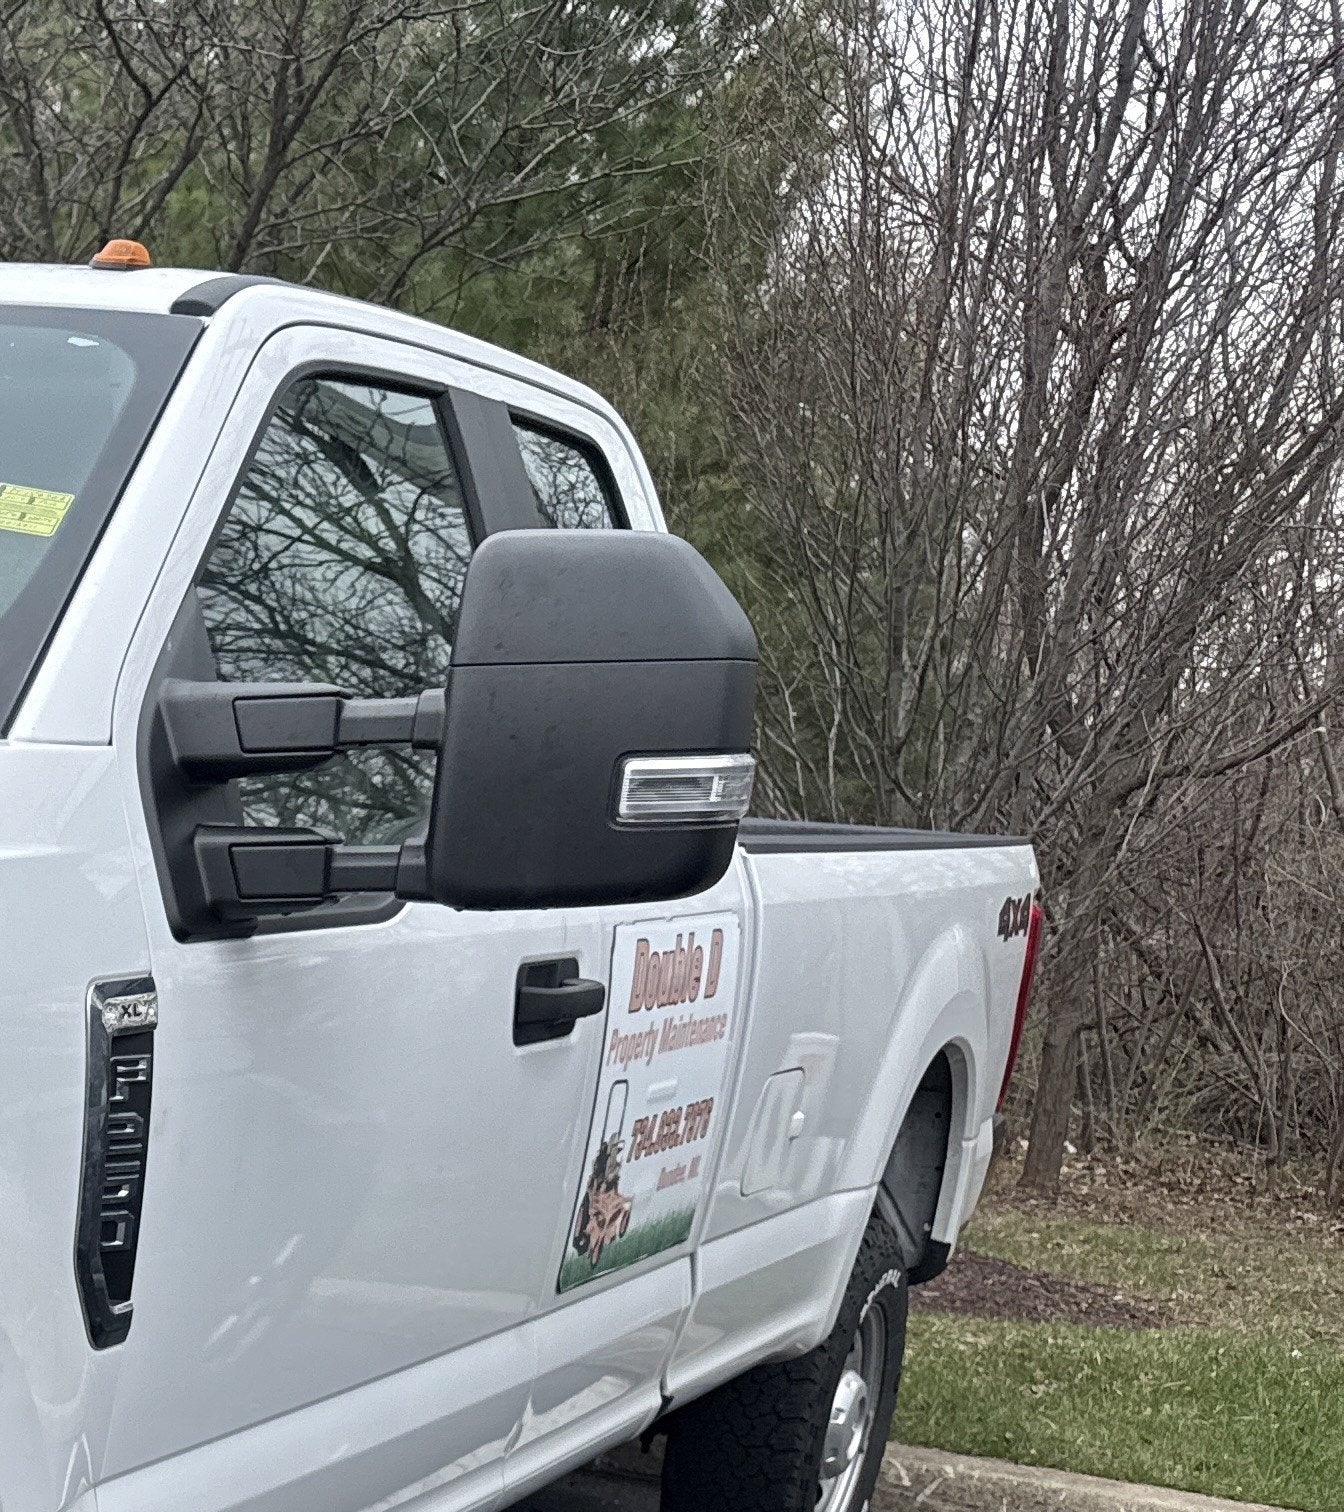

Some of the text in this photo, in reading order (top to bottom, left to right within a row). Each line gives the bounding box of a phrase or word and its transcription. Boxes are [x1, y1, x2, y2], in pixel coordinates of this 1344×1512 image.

[628, 928, 724, 1014] Double D
[121, 1002, 143, 1019] XL
[606, 1020, 660, 1072] Property
